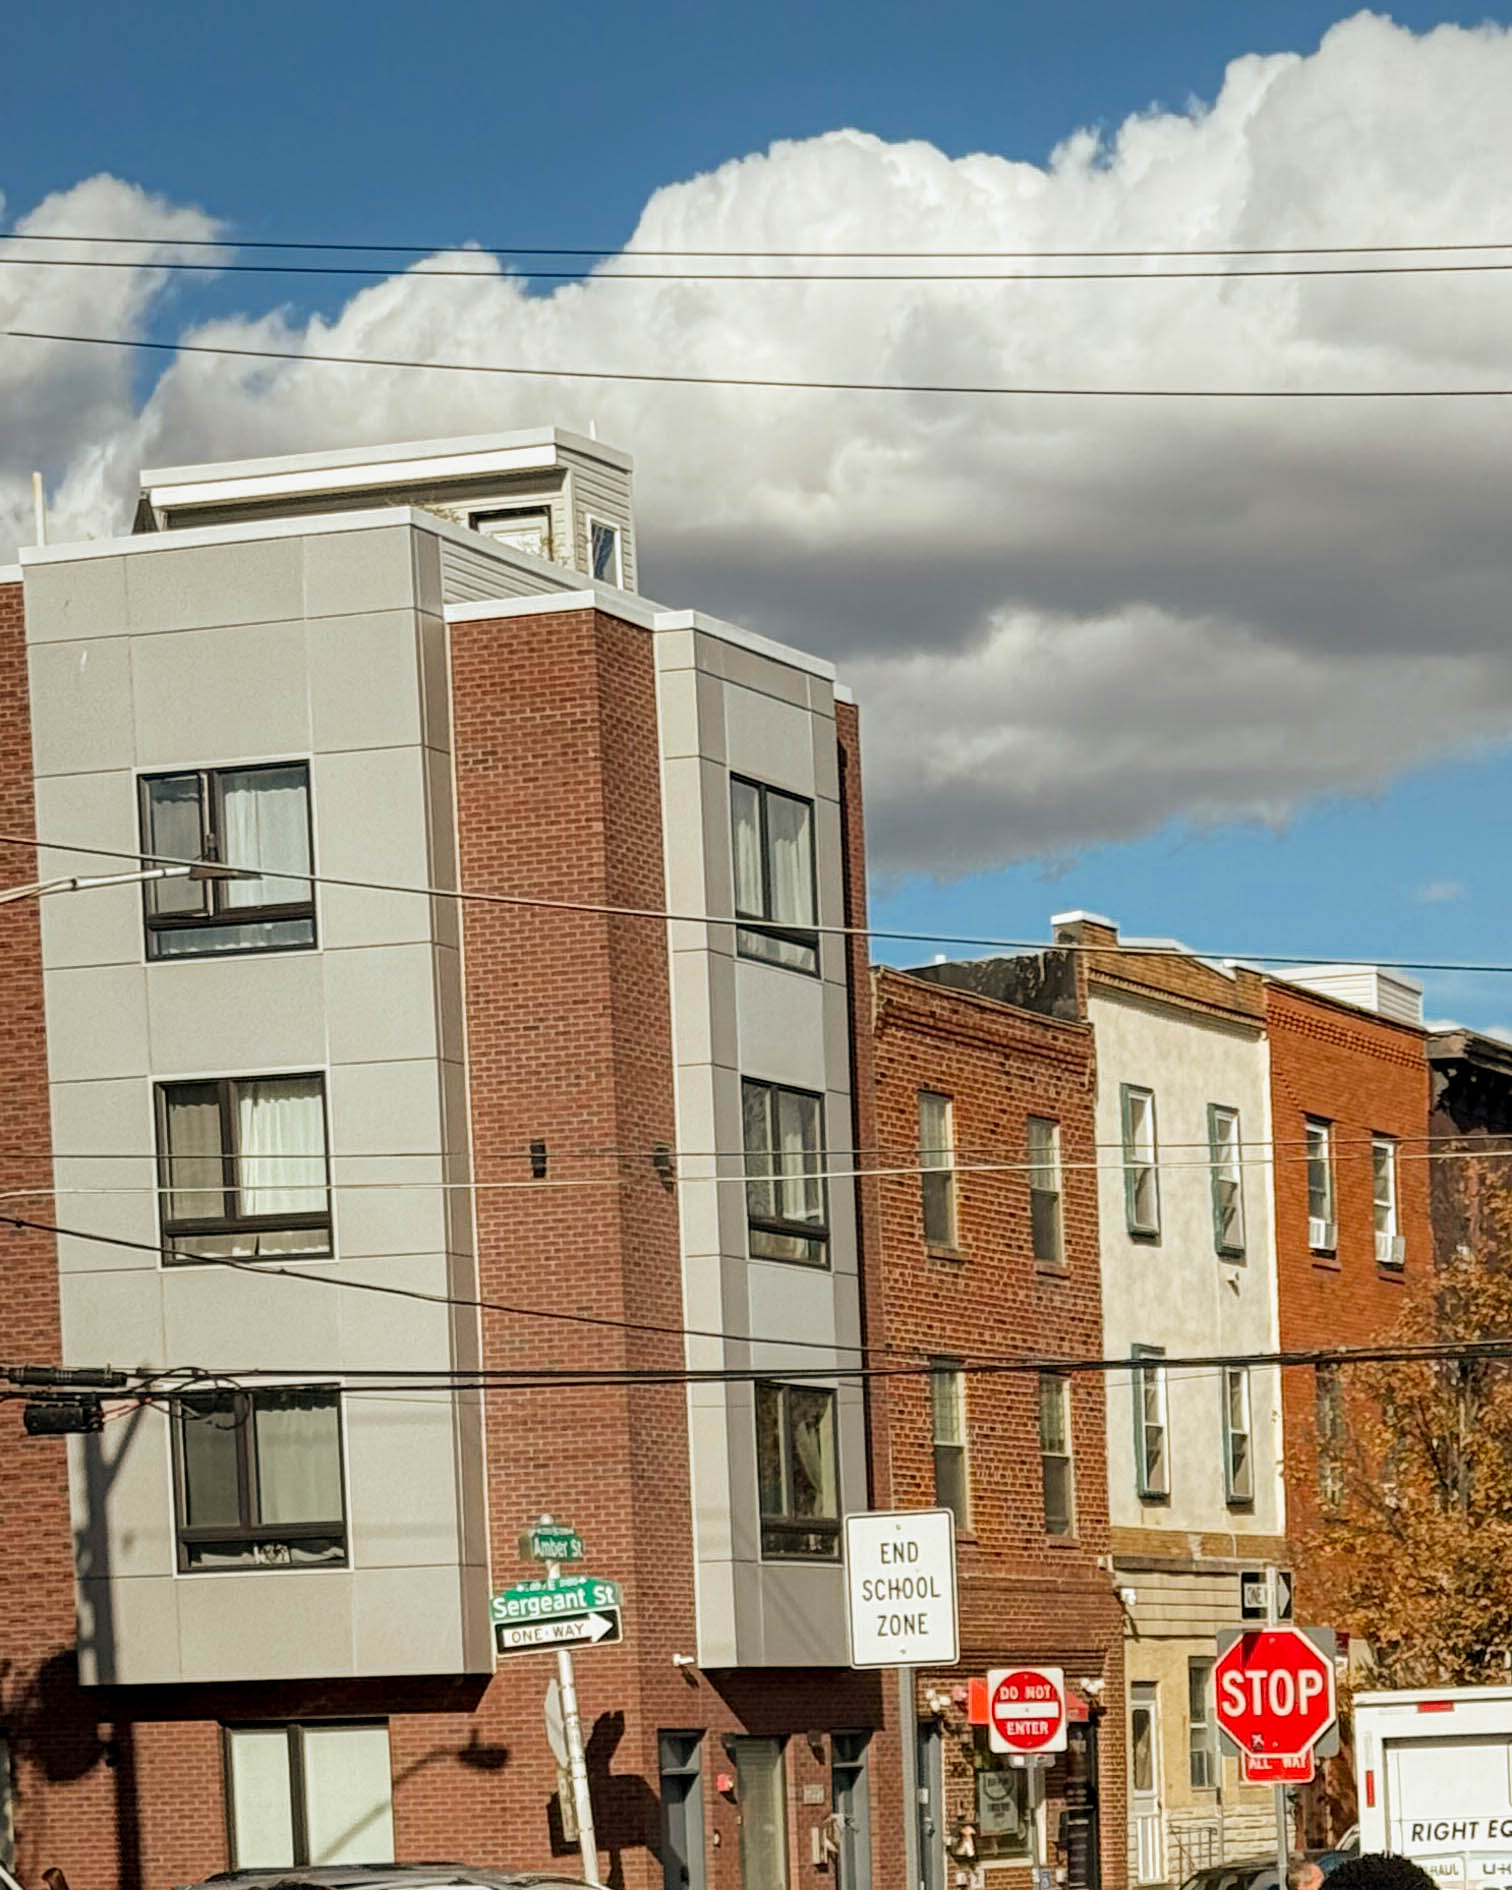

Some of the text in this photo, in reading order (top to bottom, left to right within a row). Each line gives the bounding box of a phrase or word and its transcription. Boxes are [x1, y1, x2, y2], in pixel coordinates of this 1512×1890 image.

[534, 1538, 568, 1558] Amber
[880, 1541, 919, 1564] END
[862, 1575, 941, 1601] SCHOOL
[493, 1585, 615, 1618] Sergeant St
[511, 1623, 584, 1644] ONE WAY
[877, 1613, 929, 1637] ZONE
[1000, 1684, 1051, 1700] DO NOT
[1221, 1668, 1323, 1717] STOP
[1006, 1720, 1049, 1736] ENTER
[1248, 1756, 1307, 1770] ALL WAY
[1411, 1821, 1479, 1842] RIGHT
